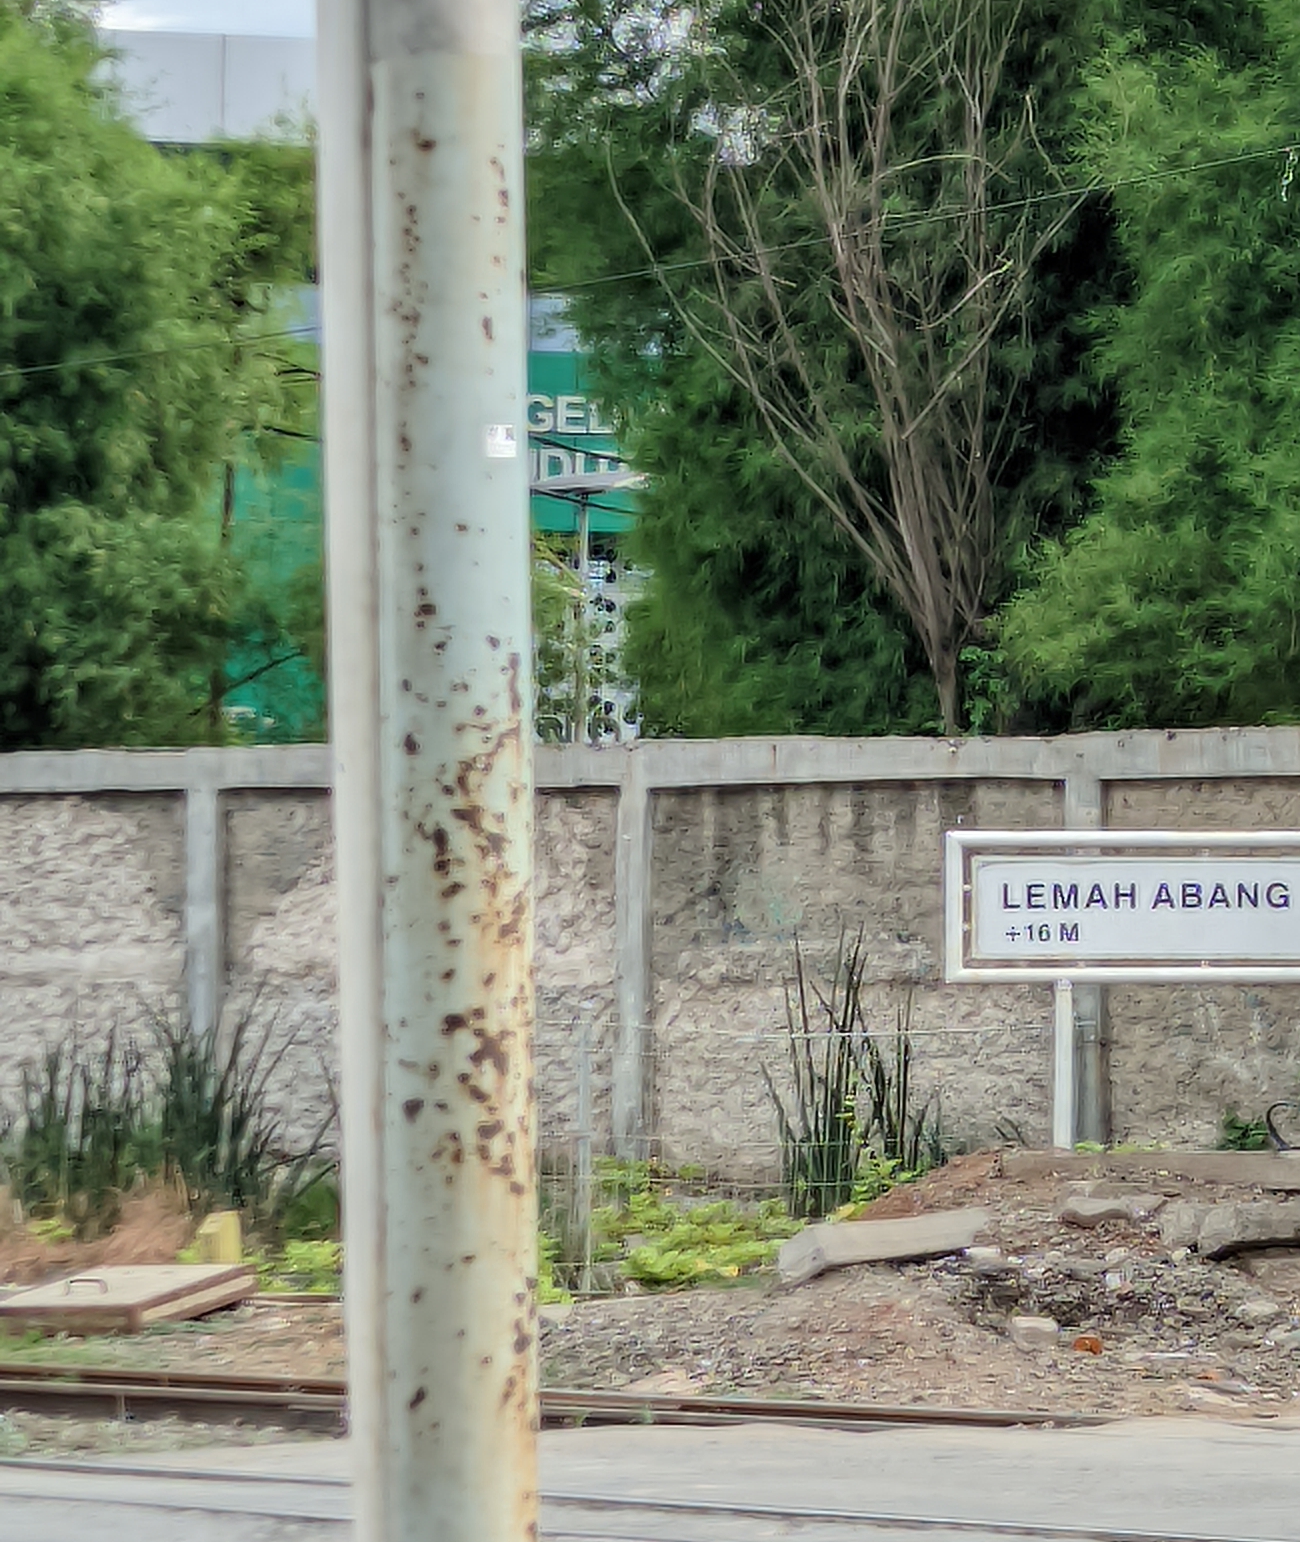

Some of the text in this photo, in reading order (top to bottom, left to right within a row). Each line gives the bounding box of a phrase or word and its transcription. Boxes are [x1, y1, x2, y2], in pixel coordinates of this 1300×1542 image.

[1002, 882, 1291, 910] LEMAH ABANG
[1059, 922, 1080, 942] M
